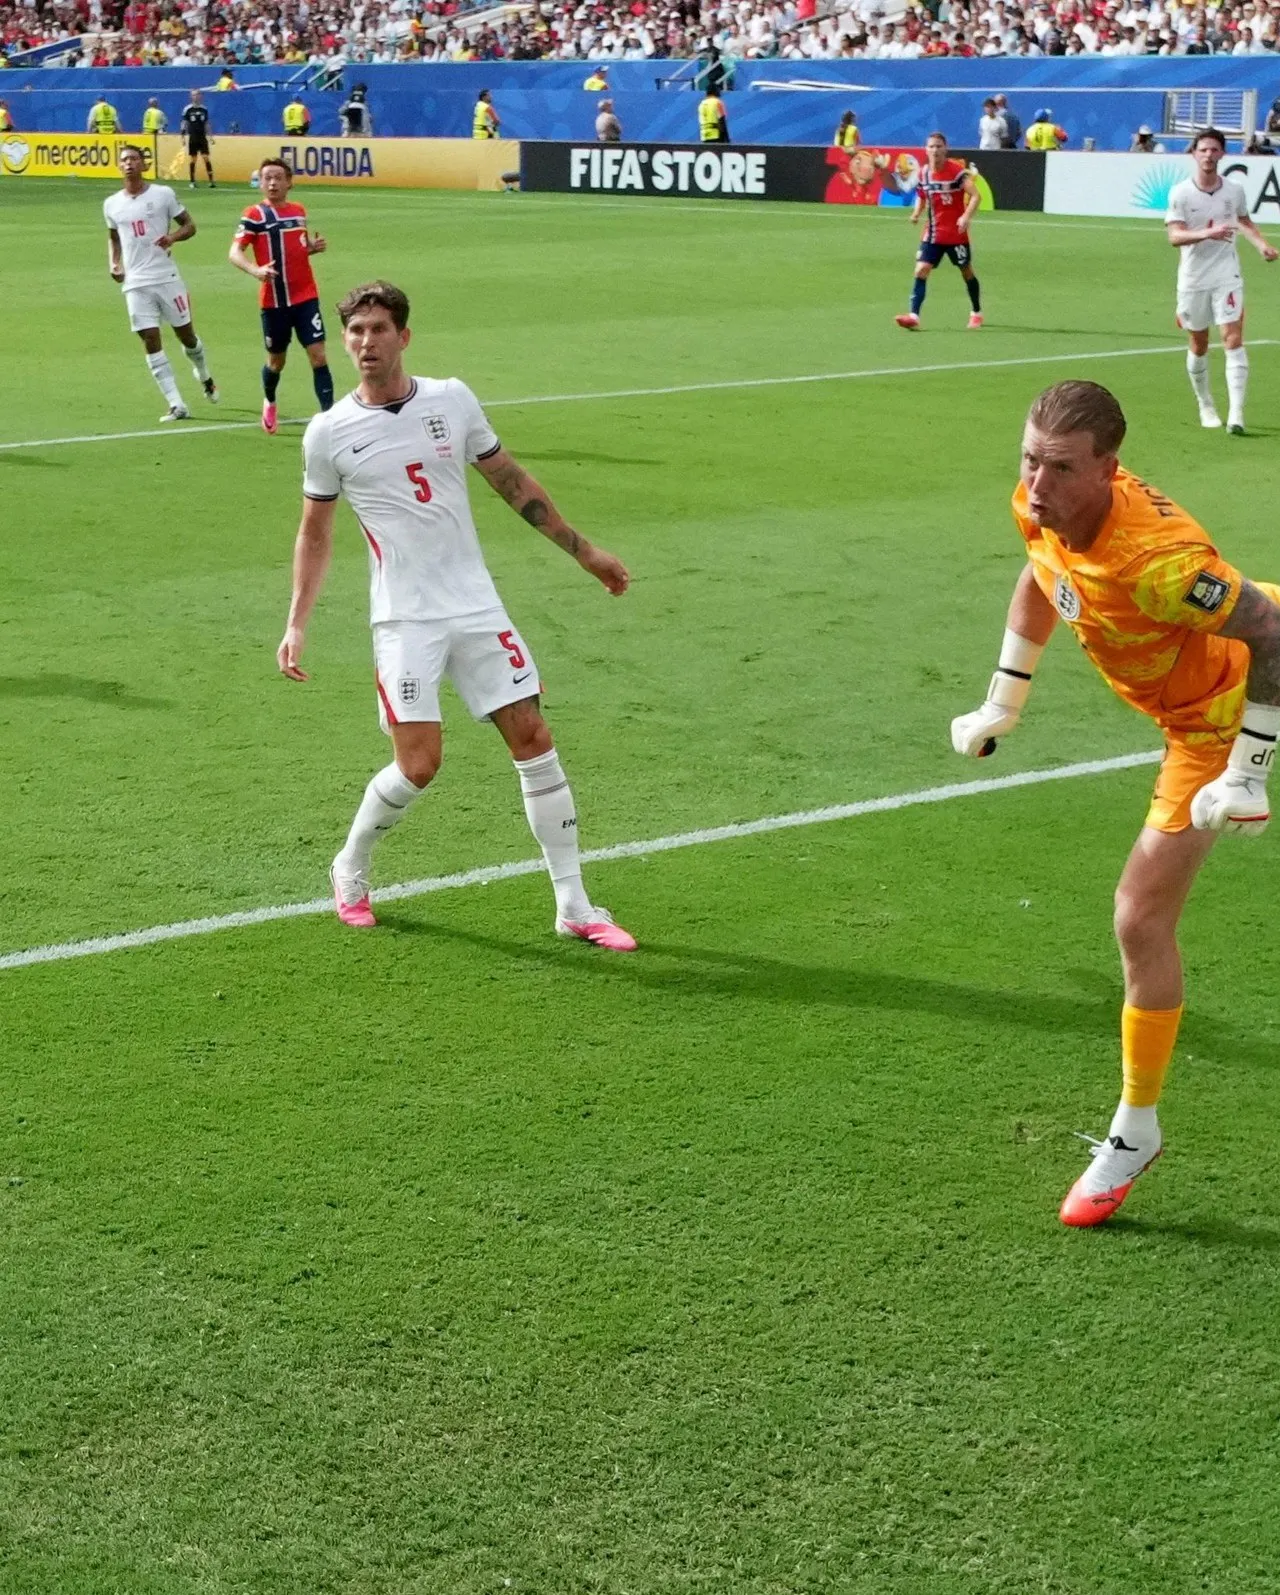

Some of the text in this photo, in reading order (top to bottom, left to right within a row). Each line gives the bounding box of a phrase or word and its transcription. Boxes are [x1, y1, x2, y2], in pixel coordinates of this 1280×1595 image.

[35, 140, 109, 167] mercado
[280, 146, 374, 177] FLORIDA
[570, 148, 767, 194] FIFA STORE
[131, 219, 146, 238] 10
[1226, 291, 1235, 308] 4
[311, 312, 323, 331] 6
[405, 462, 432, 503] 5
[497, 630, 526, 669] 5
